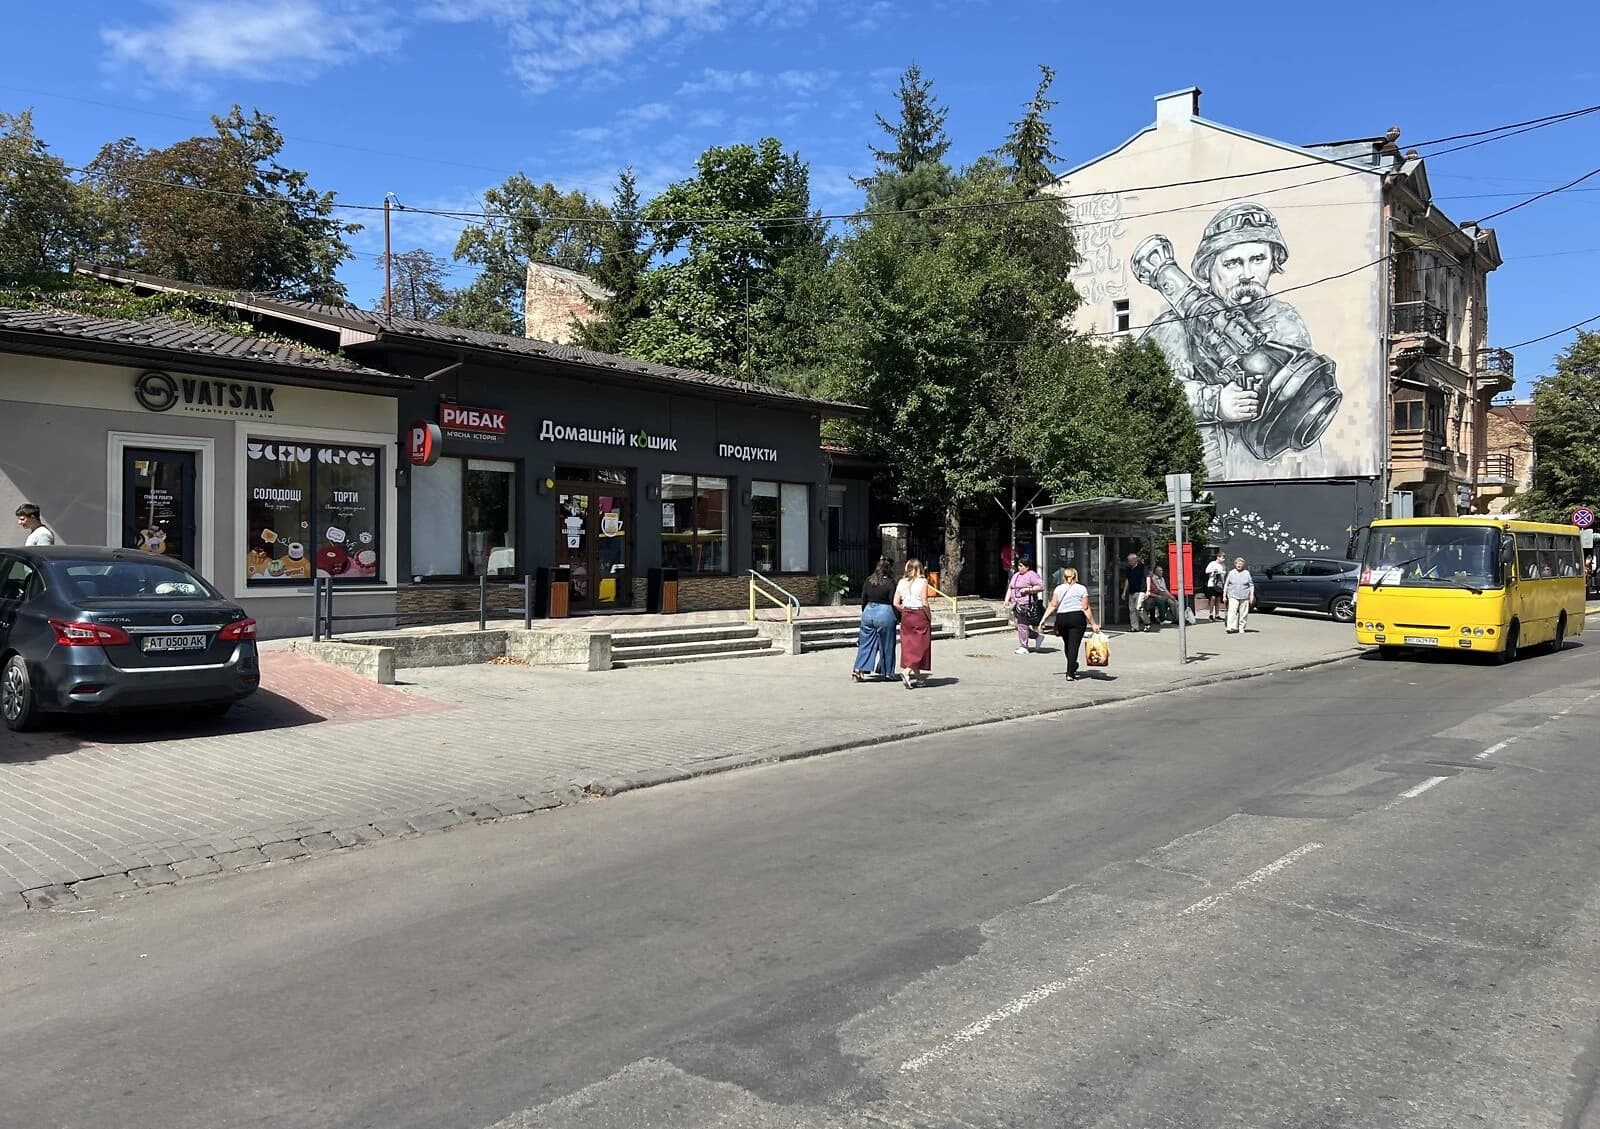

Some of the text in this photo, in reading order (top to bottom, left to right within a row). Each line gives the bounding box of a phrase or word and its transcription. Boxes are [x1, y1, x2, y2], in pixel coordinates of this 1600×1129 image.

[182, 378, 275, 412] VATSAK
[443, 408, 505, 429] РИБАК
[447, 431, 471, 439] М'ЯСНА
[539, 420, 678, 452] Домашній кошик
[719, 444, 777, 462] ПРОДУКТИ
[253, 487, 302, 503] СОЛОДОЩІ
[333, 491, 359, 503] ТОРТИ
[150, 636, 204, 648] AT 0500 AK
